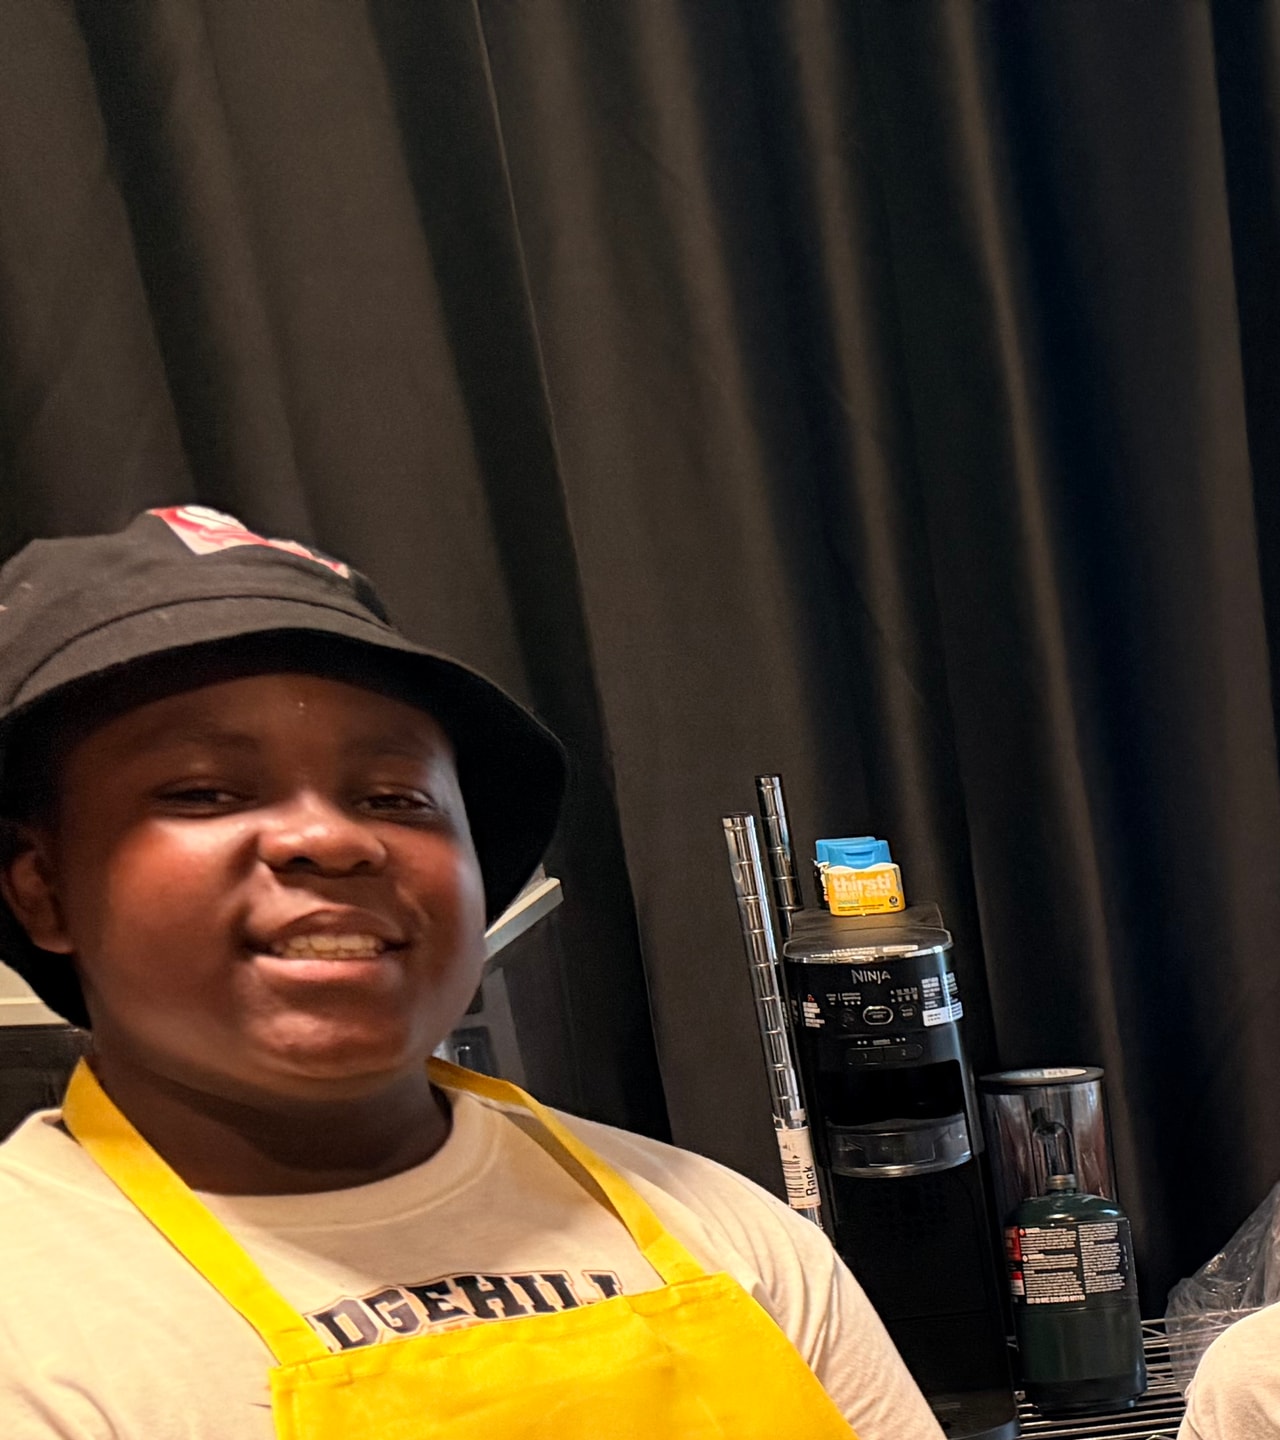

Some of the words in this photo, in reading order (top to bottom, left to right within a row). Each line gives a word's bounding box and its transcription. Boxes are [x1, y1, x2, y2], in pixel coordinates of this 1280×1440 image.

[832, 873, 891, 891] thirsti
[851, 969, 891, 985] NINJA
[803, 1165, 817, 1196] Rack
[310, 1271, 624, 1353] DGEHIL
